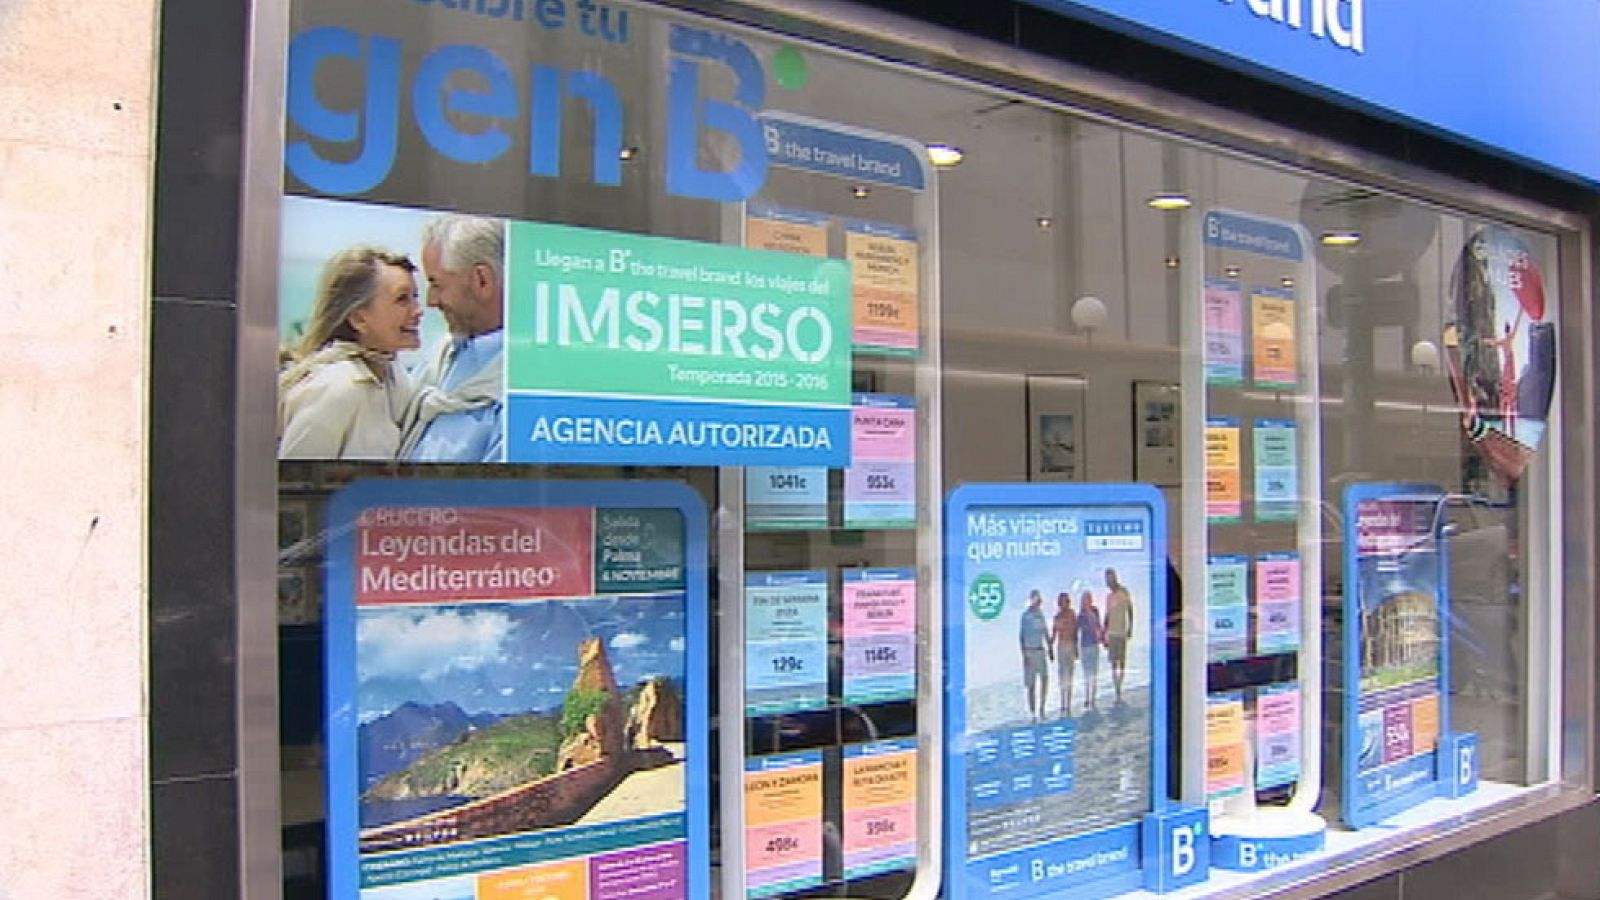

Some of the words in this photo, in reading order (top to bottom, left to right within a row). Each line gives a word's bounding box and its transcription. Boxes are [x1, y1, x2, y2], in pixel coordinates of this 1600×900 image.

[284, 26, 623, 194] gen
[666, 23, 769, 202] B
[784, 141, 811, 160] the
[813, 147, 856, 169] travel
[858, 153, 901, 177] brand
[535, 248, 593, 272] Llegan
[595, 258, 605, 271] a
[630, 260, 655, 275] the
[657, 262, 698, 282] travel
[700, 265, 741, 285] brand
[745, 271, 765, 288] los
[767, 274, 805, 294] viajes
[807, 279, 830, 296] del
[534, 281, 832, 362] IMSERSO
[667, 363, 751, 386] Temporada
[530, 416, 662, 445] AGENCIA
[667, 420, 832, 450] AUTORIZADA
[358, 507, 458, 527] CRUCERO
[602, 513, 641, 529] Salida
[967, 512, 1007, 537] Más
[1008, 514, 1078, 541] viajeros
[361, 528, 495, 562] Leyendas
[500, 527, 541, 554] del
[601, 530, 640, 547] desde
[967, 540, 1003, 563] que
[1006, 538, 1061, 557] nunca
[602, 548, 642, 565] Palma
[361, 562, 553, 594] Mediterráneo
[1460, 747, 1472, 784] B
[1171, 825, 1196, 877] B
[1238, 842, 1258, 867] B
[1031, 858, 1044, 882] B
